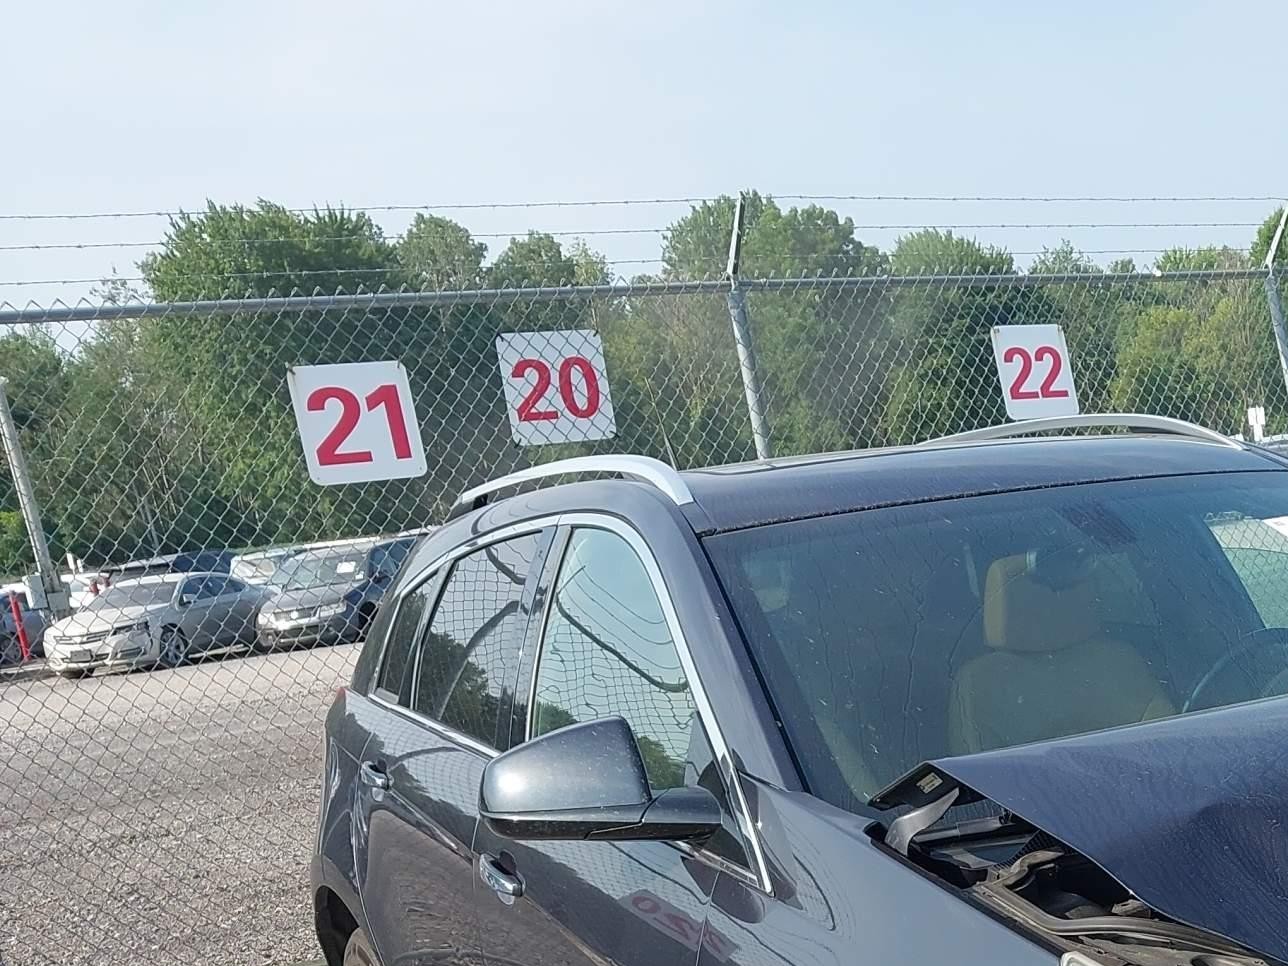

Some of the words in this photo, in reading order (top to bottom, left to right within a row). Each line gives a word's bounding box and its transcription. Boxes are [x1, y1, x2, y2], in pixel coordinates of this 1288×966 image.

[512, 356, 600, 422] 20
[1004, 346, 1069, 400] 22
[307, 384, 412, 466] 21
